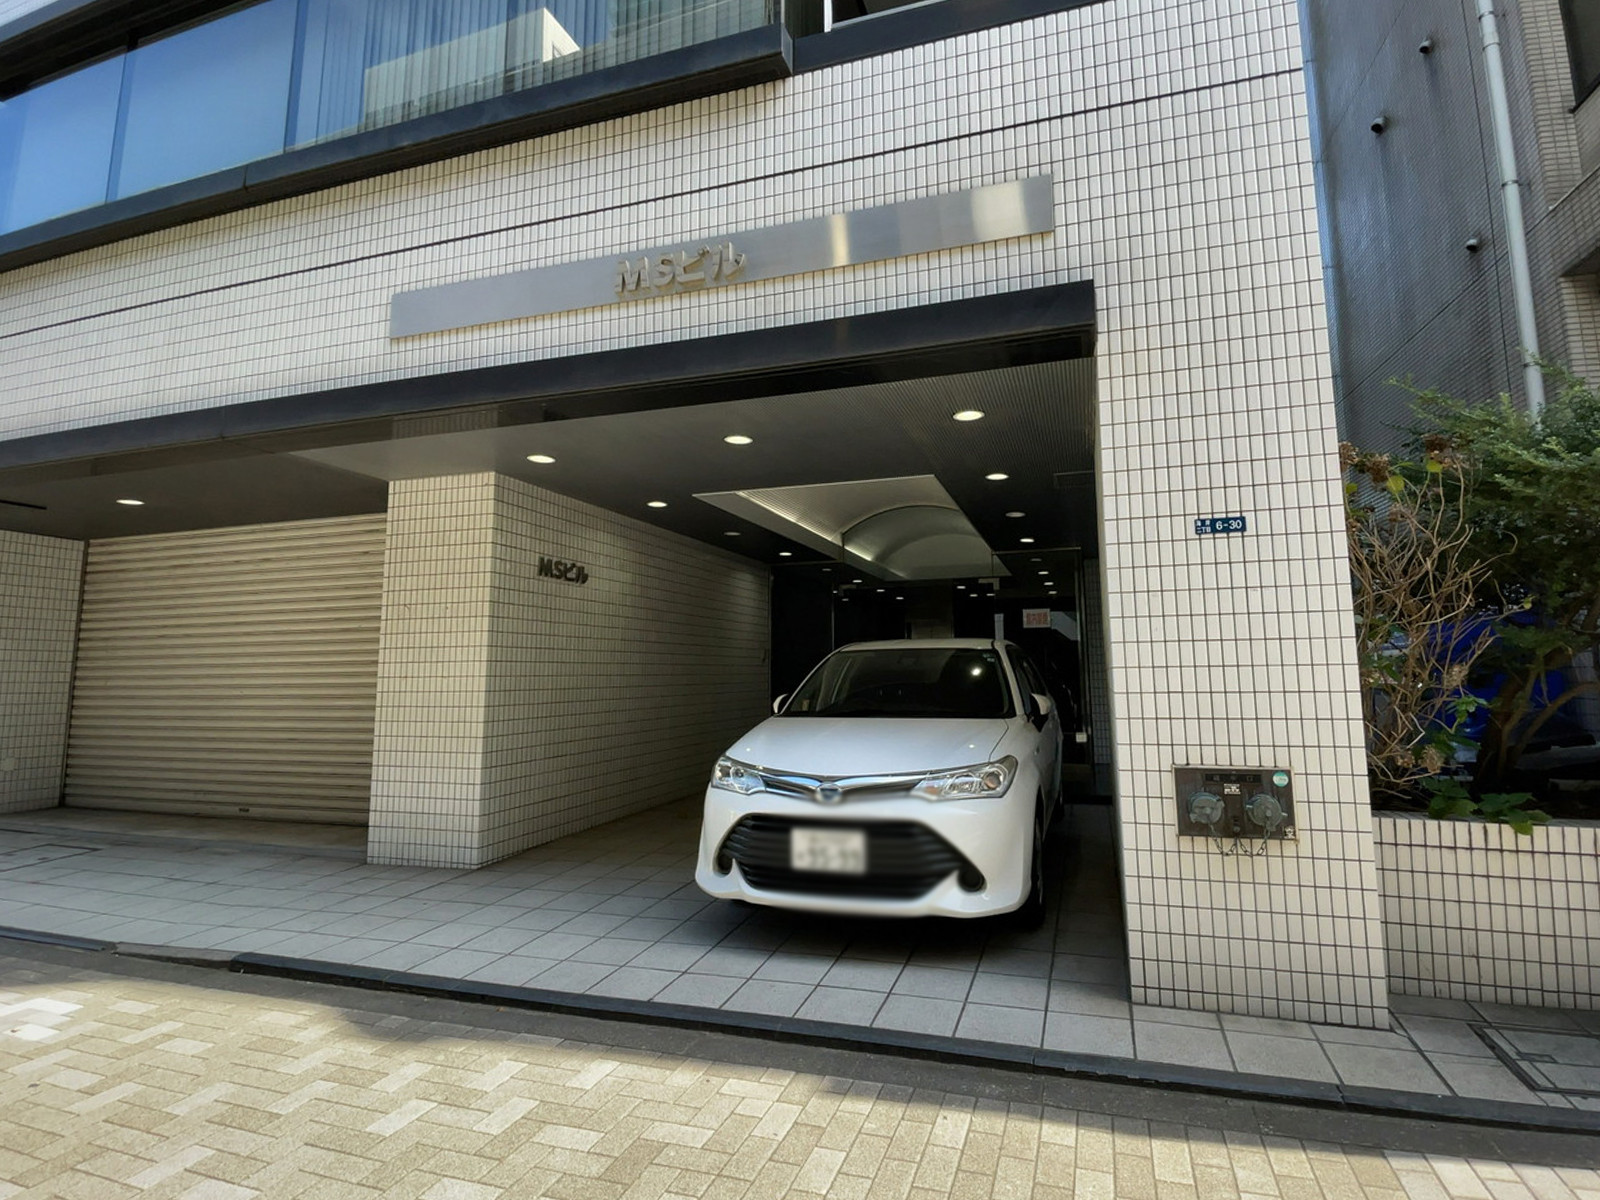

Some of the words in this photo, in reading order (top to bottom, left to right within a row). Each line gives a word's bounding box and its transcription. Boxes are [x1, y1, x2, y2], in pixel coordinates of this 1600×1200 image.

[615, 242, 746, 296] MSビル
[1215, 519, 1243, 531] 6-30
[538, 556, 589, 585] MSビル
